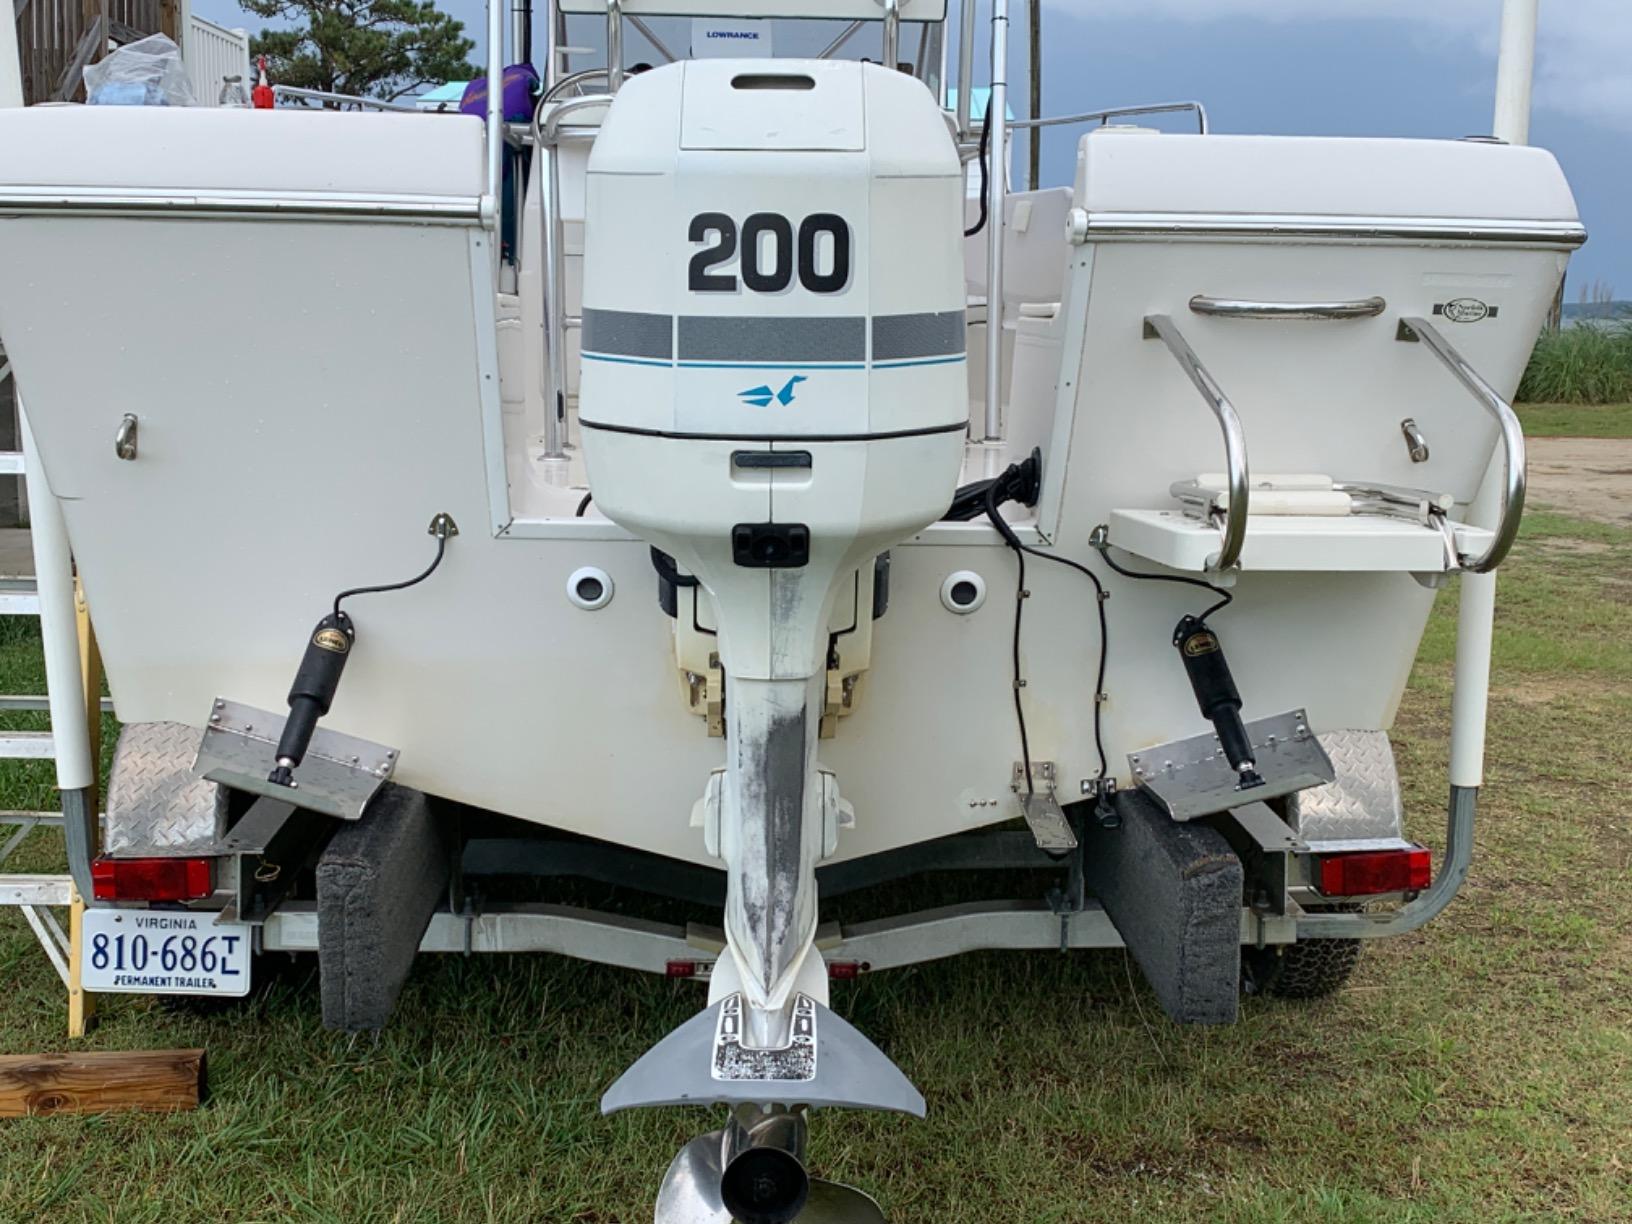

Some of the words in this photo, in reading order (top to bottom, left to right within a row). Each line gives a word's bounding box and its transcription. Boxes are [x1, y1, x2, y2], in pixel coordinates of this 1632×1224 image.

[706, 31, 760, 40] LOWRANCE
[688, 212, 852, 293] 200
[135, 917, 198, 930] VIRGINIA
[115, 975, 171, 988] PERMANENT
[175, 976, 214, 989] TRAILER
